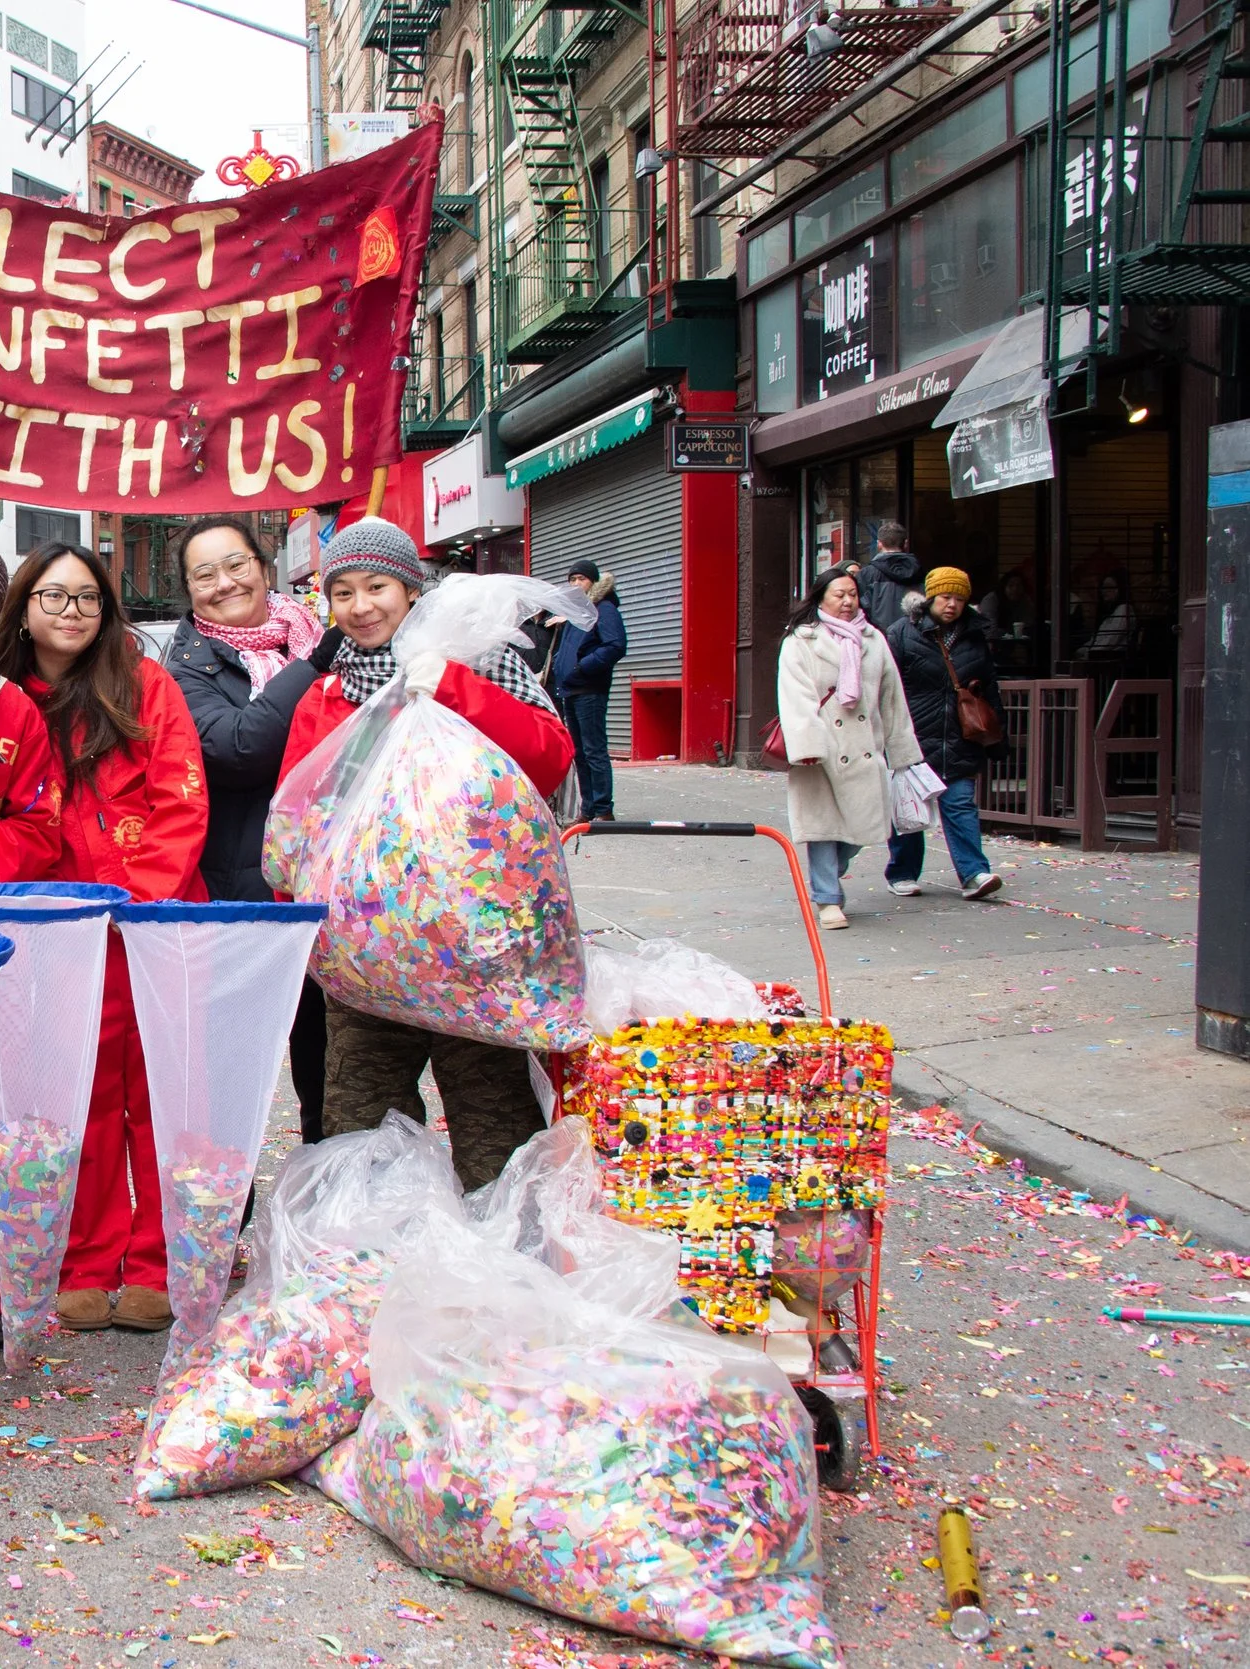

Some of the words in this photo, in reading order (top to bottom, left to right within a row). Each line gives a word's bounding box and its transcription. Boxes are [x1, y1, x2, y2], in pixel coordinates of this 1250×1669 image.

[824, 264, 869, 334] 咖啡
[825, 342, 868, 378] COFFEE
[876, 376, 922, 414] Silkroad
[922, 371, 950, 398] Place
[227, 382, 356, 497] US!
[677, 442, 743, 453] CAPPUCCINO
[685, 429, 735, 439] ESPRESSO
[993, 462, 1009, 474] SILK
[1009, 457, 1029, 471] ROAD
